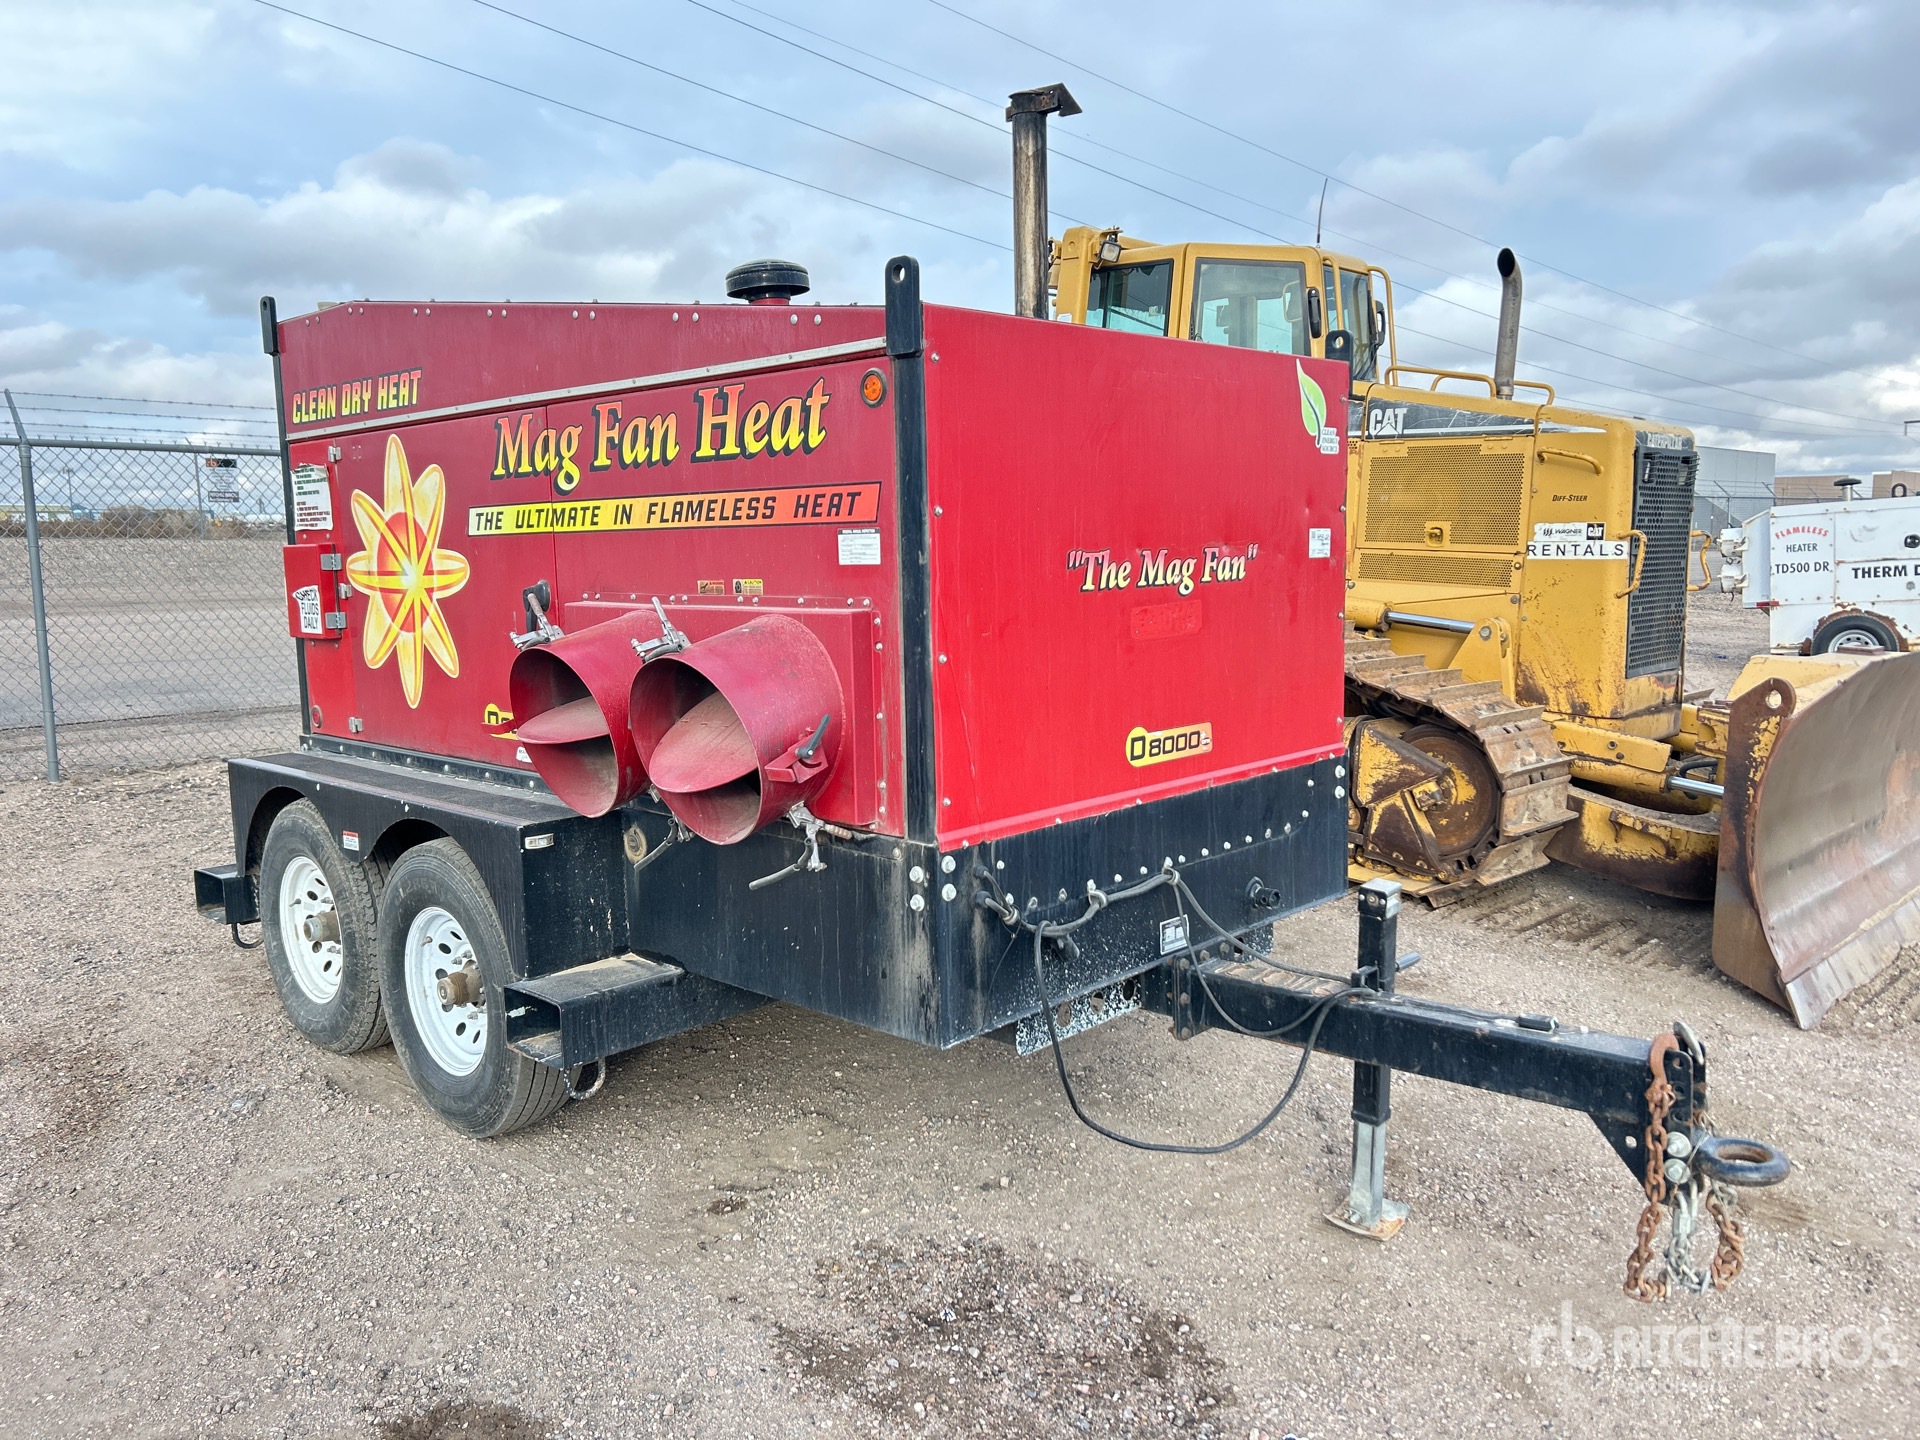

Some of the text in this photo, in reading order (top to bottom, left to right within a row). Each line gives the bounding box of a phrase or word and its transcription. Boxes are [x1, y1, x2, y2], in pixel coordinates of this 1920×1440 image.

[292, 368, 422, 425] CLEAN DRY HEAT
[1369, 407, 1409, 436] CAT
[490, 376, 832, 496] Mag Fan Heat
[475, 491, 862, 531] THE ULTIMATE IN FLAMELESS HEAT
[1587, 526, 1604, 537] CAT
[1775, 526, 1829, 539] FLAMELESS
[1527, 544, 1624, 556] RENTALS
[1786, 543, 1818, 553] HEATER
[1136, 548, 1197, 598] Mag
[1775, 561, 1830, 574] TD500 DR
[1852, 565, 1908, 579] THERM
